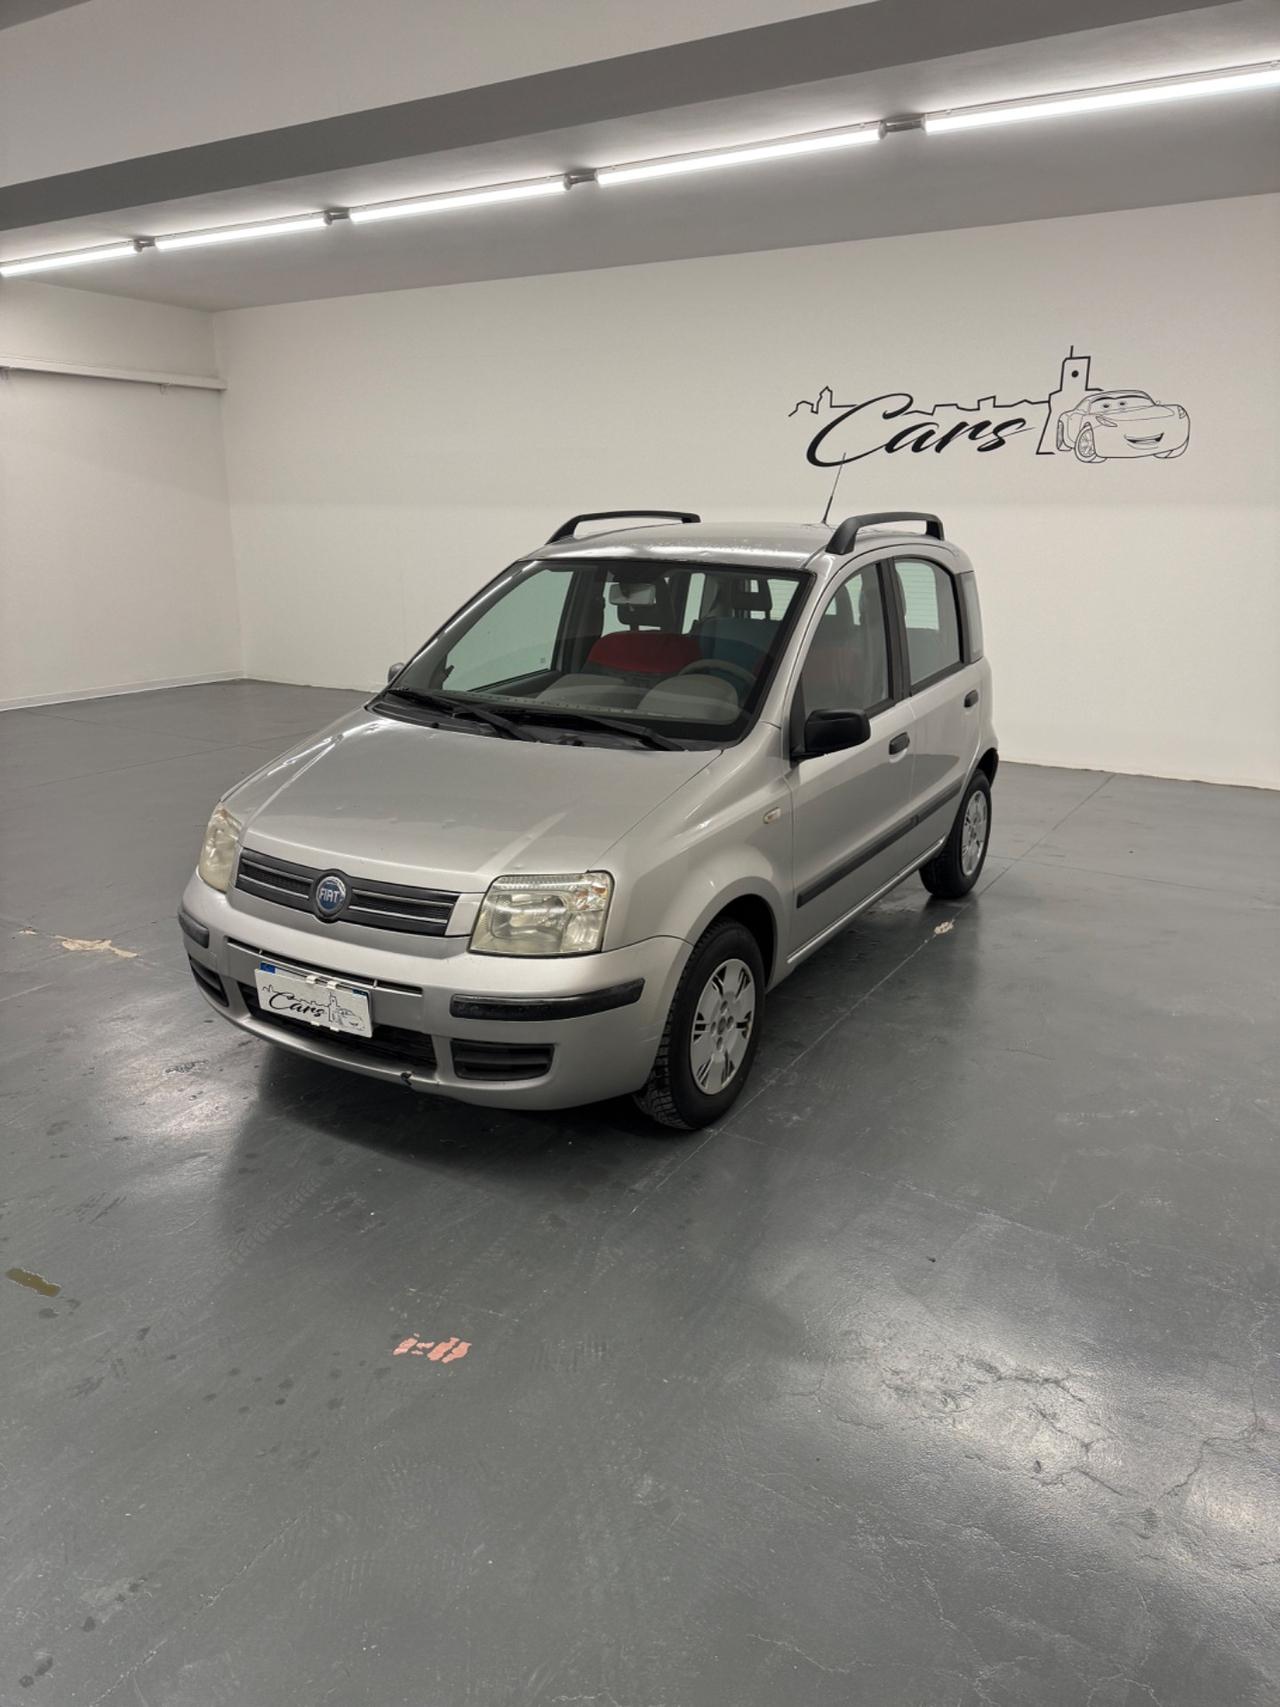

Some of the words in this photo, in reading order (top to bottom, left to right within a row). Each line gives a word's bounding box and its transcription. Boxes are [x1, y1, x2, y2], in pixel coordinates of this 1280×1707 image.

[806, 393, 1031, 467] Cars
[319, 888, 340, 903] FIAT
[268, 992, 325, 1017] Cars
